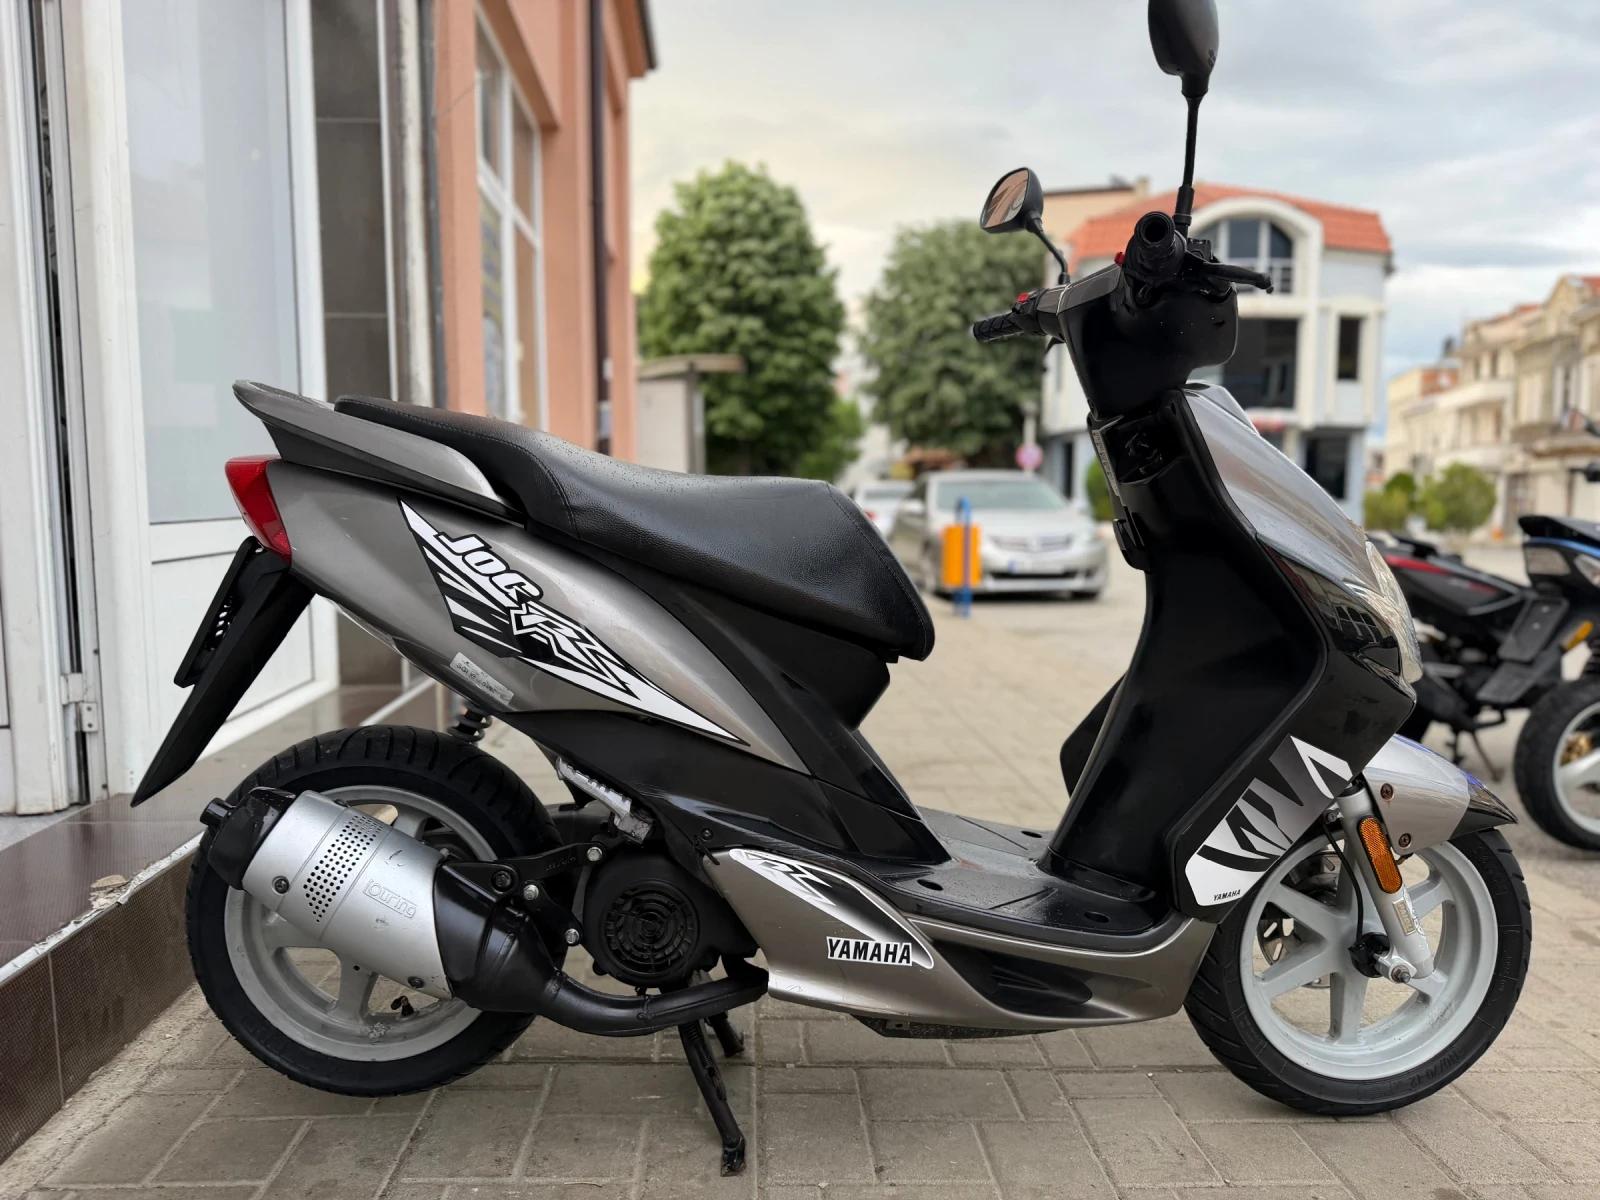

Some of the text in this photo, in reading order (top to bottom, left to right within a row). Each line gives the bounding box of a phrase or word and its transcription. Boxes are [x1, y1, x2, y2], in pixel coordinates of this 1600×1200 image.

[436, 533, 542, 601] JOG
[1213, 889, 1241, 901] YAMAHA
[828, 938, 911, 964] YAMAHA
